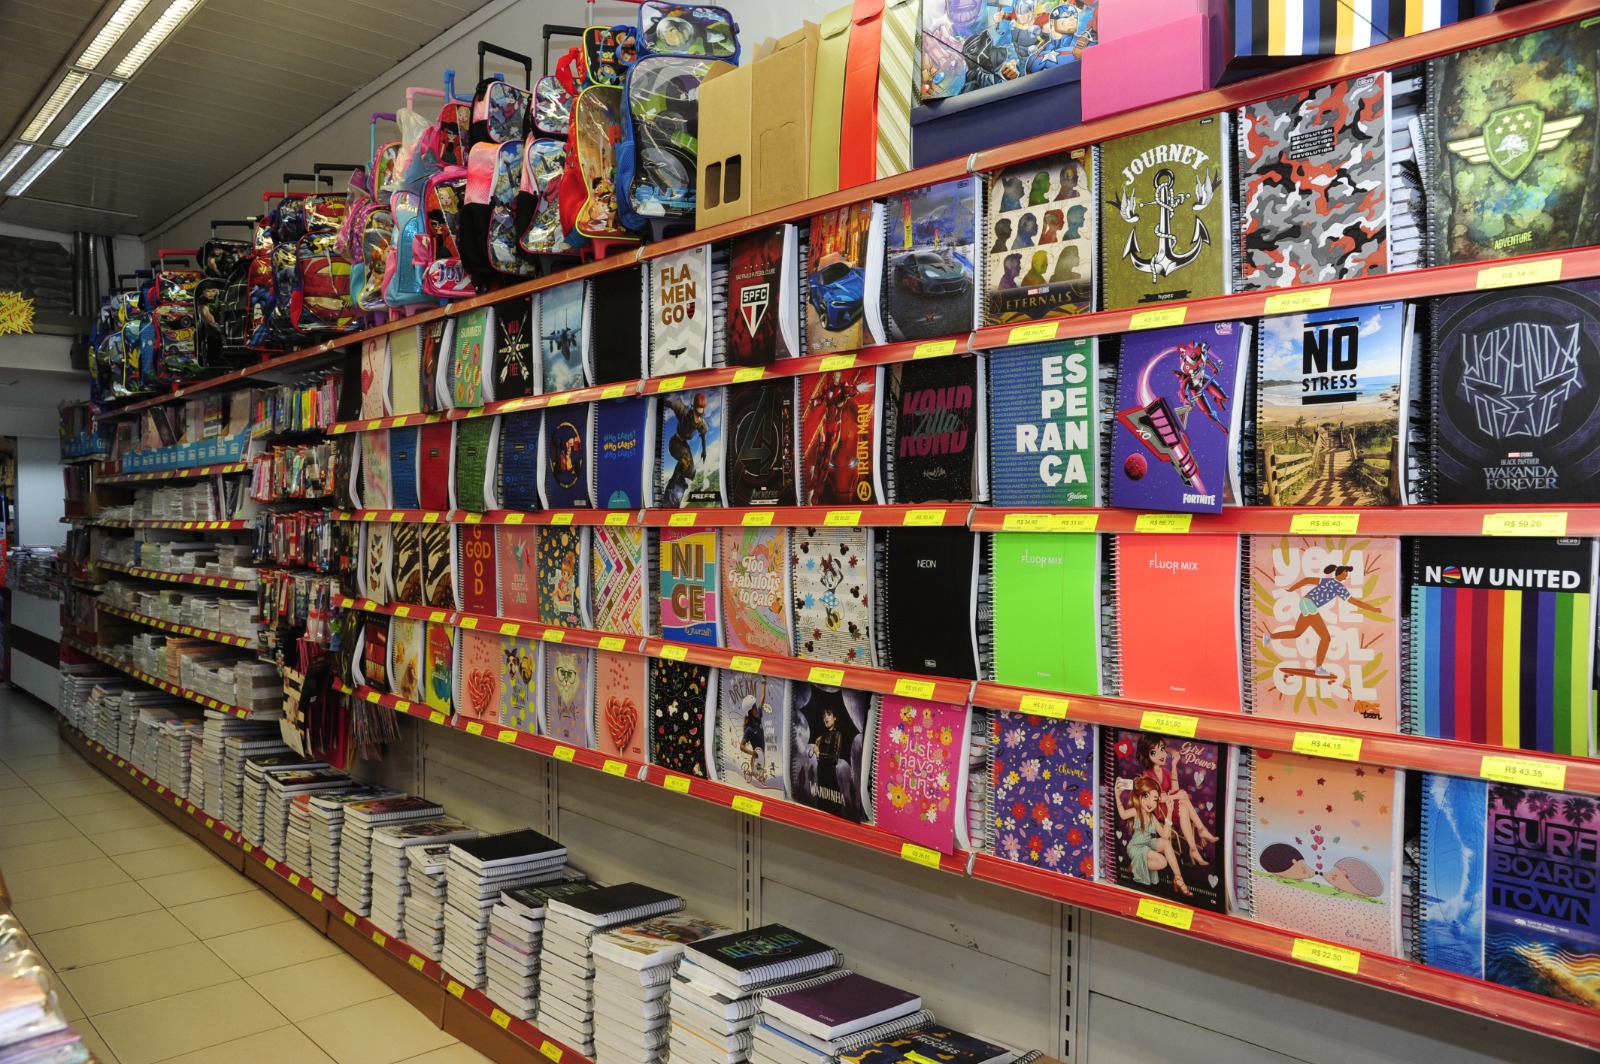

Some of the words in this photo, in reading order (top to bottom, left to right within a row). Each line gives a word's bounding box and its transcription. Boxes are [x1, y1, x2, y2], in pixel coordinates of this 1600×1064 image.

[1292, 128, 1333, 141] REVOLUTION
[1292, 138, 1333, 150] REVOLUTION
[1292, 147, 1333, 159] REVOLUTION
[1122, 143, 1210, 186] JOURNEY
[1494, 231, 1533, 250] ADVENTURE
[660, 263, 691, 287] FLA
[661, 281, 696, 306] MEN
[742, 286, 767, 303] SPFC
[1006, 291, 1072, 311] ETERNALS
[661, 304, 685, 326] GO
[461, 325, 482, 339] SUMMER
[1303, 325, 1359, 376] NO
[1042, 353, 1087, 386] ES
[1302, 373, 1357, 393] STRESS
[1042, 387, 1088, 419] PE
[858, 403, 869, 435] MAN
[1016, 420, 1089, 452] RAN
[603, 442, 617, 452] WHO
[858, 440, 869, 475] IRON
[1040, 455, 1088, 487] ÇA
[1483, 465, 1559, 480] WAKANDA
[1486, 476, 1559, 491] FOREVER
[1182, 493, 1215, 505] FORTNITE
[741, 555, 764, 573] Too
[916, 559, 936, 568] NEON
[1048, 556, 1063, 565] MIX
[1180, 561, 1199, 571] MIX
[728, 569, 781, 596] Fabulous
[1489, 568, 1581, 590] UNITED
[729, 680, 757, 705] DREAM
[1180, 742, 1203, 756] Girl
[1311, 740, 1321, 748] R$
[1186, 754, 1218, 771] Power
[1505, 765, 1517, 774] R$
[809, 781, 845, 807] WANDINHA
[1493, 815, 1600, 862] SURF
[1493, 852, 1596, 891] BOARD
[1493, 887, 1591, 925] TOWN
[1311, 948, 1321, 957] R$
[912, 1035, 960, 1054] PROCESS
